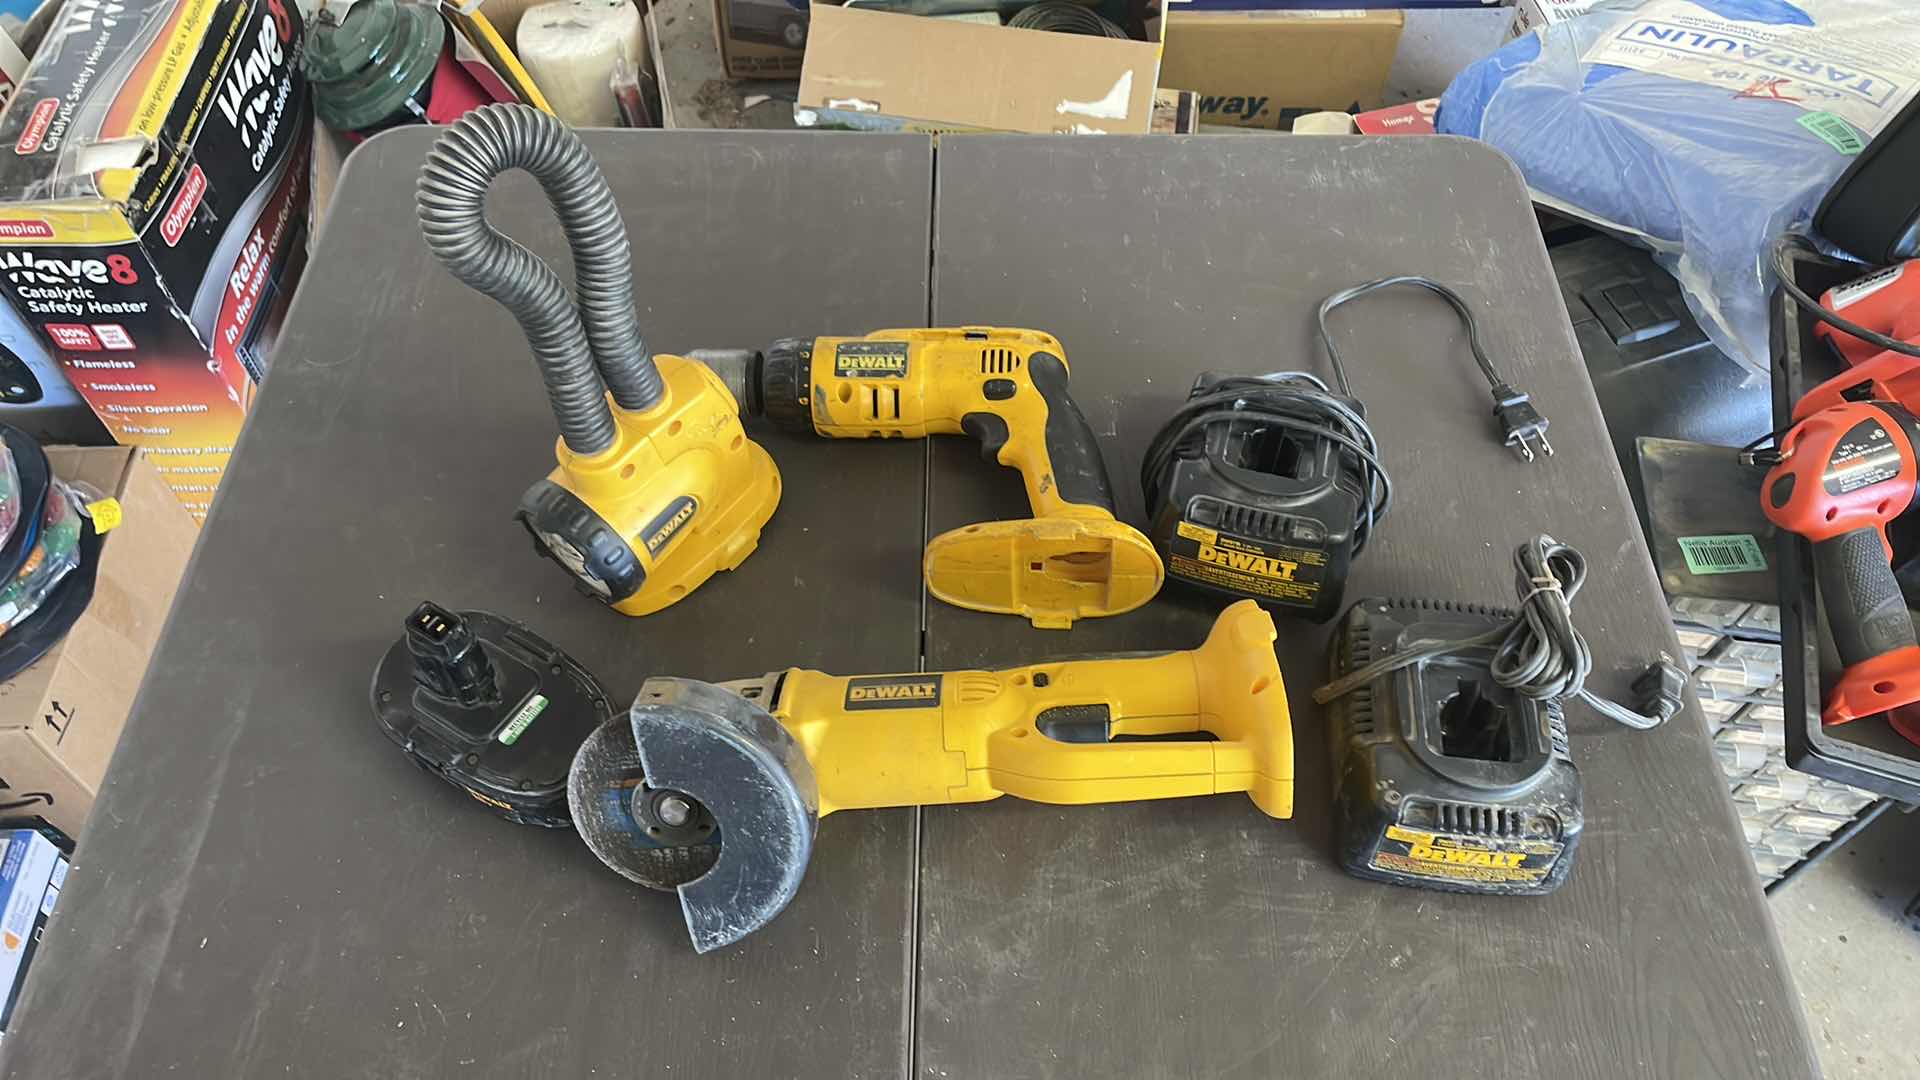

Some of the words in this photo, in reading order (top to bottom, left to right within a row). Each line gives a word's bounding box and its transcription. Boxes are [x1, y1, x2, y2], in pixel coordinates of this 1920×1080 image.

[1637, 24, 1875, 97] TARPAULIN
[42, 101, 76, 151] Catalytic
[66, 66, 96, 101] Safety
[84, 30, 112, 66] Heater
[252, 112, 279, 172] Catalytic
[166, 174, 202, 235] Olympian
[230, 227, 264, 299] Relax
[17, 285, 95, 301] Catalytic
[236, 297, 251, 325] the
[249, 252, 270, 297] warm
[27, 301, 83, 316] Safety
[86, 301, 148, 314] Heater
[52, 327, 90, 339] 100%
[60, 337, 92, 346] SAFETY
[73, 359, 136, 370] Flameless
[90, 382, 156, 392] Smokeless
[107, 404, 143, 414] Silent
[145, 404, 208, 414] Operation
